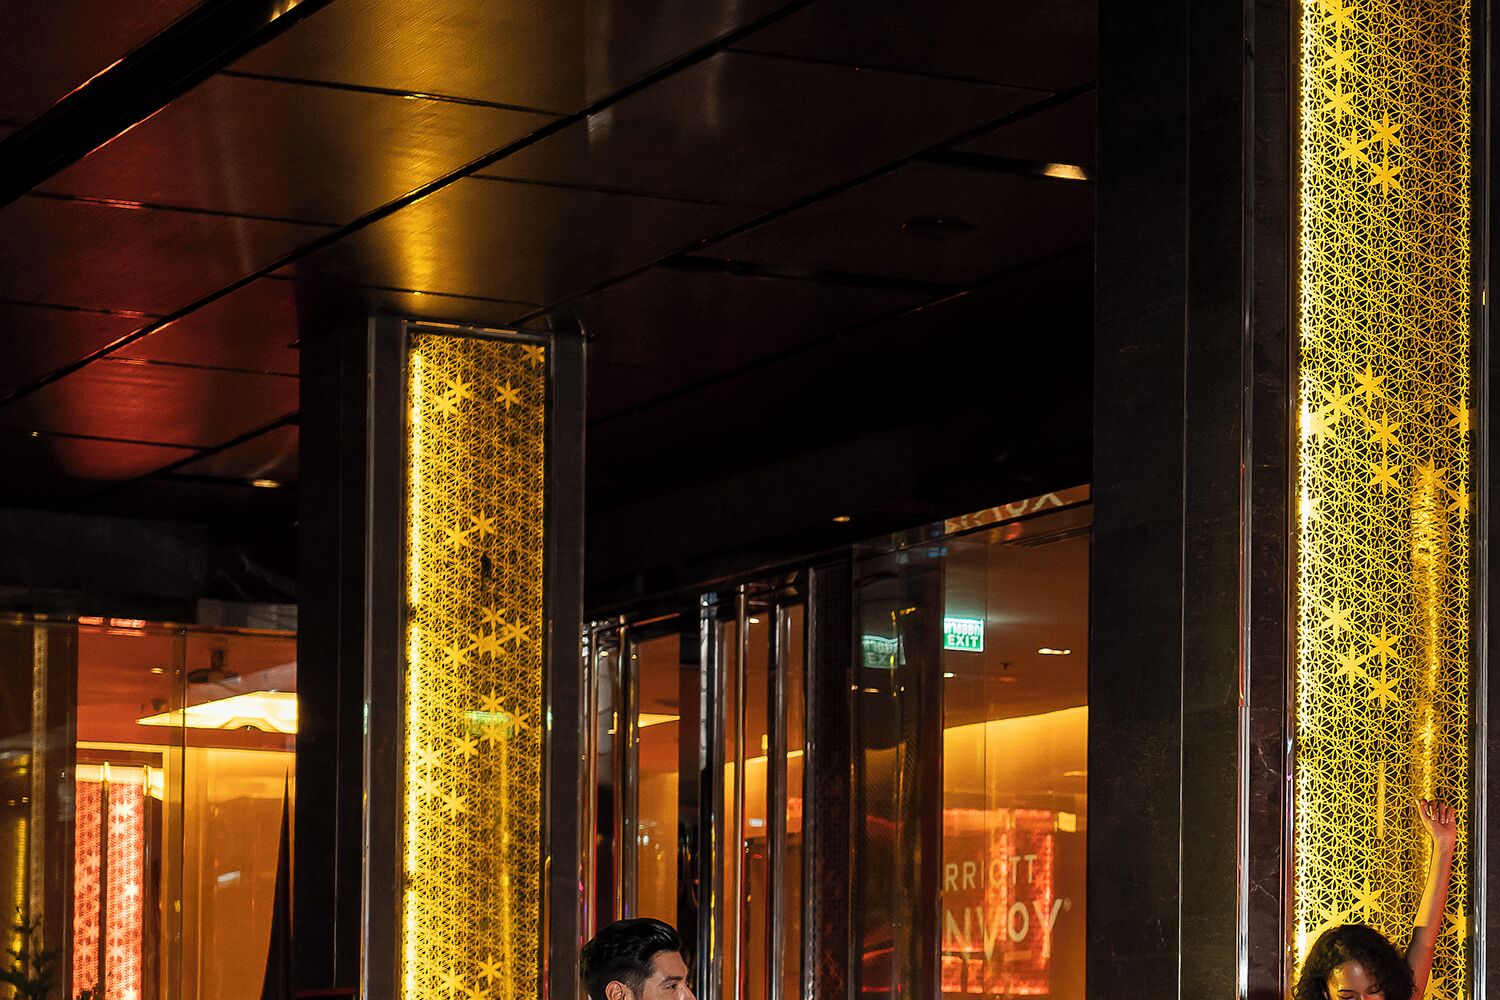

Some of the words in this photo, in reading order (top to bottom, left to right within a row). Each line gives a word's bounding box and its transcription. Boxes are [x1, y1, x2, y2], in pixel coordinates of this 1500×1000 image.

[947, 634, 979, 648] EXIT
[945, 854, 1038, 893] RRIOTT
[945, 898, 1063, 962] NVOY
